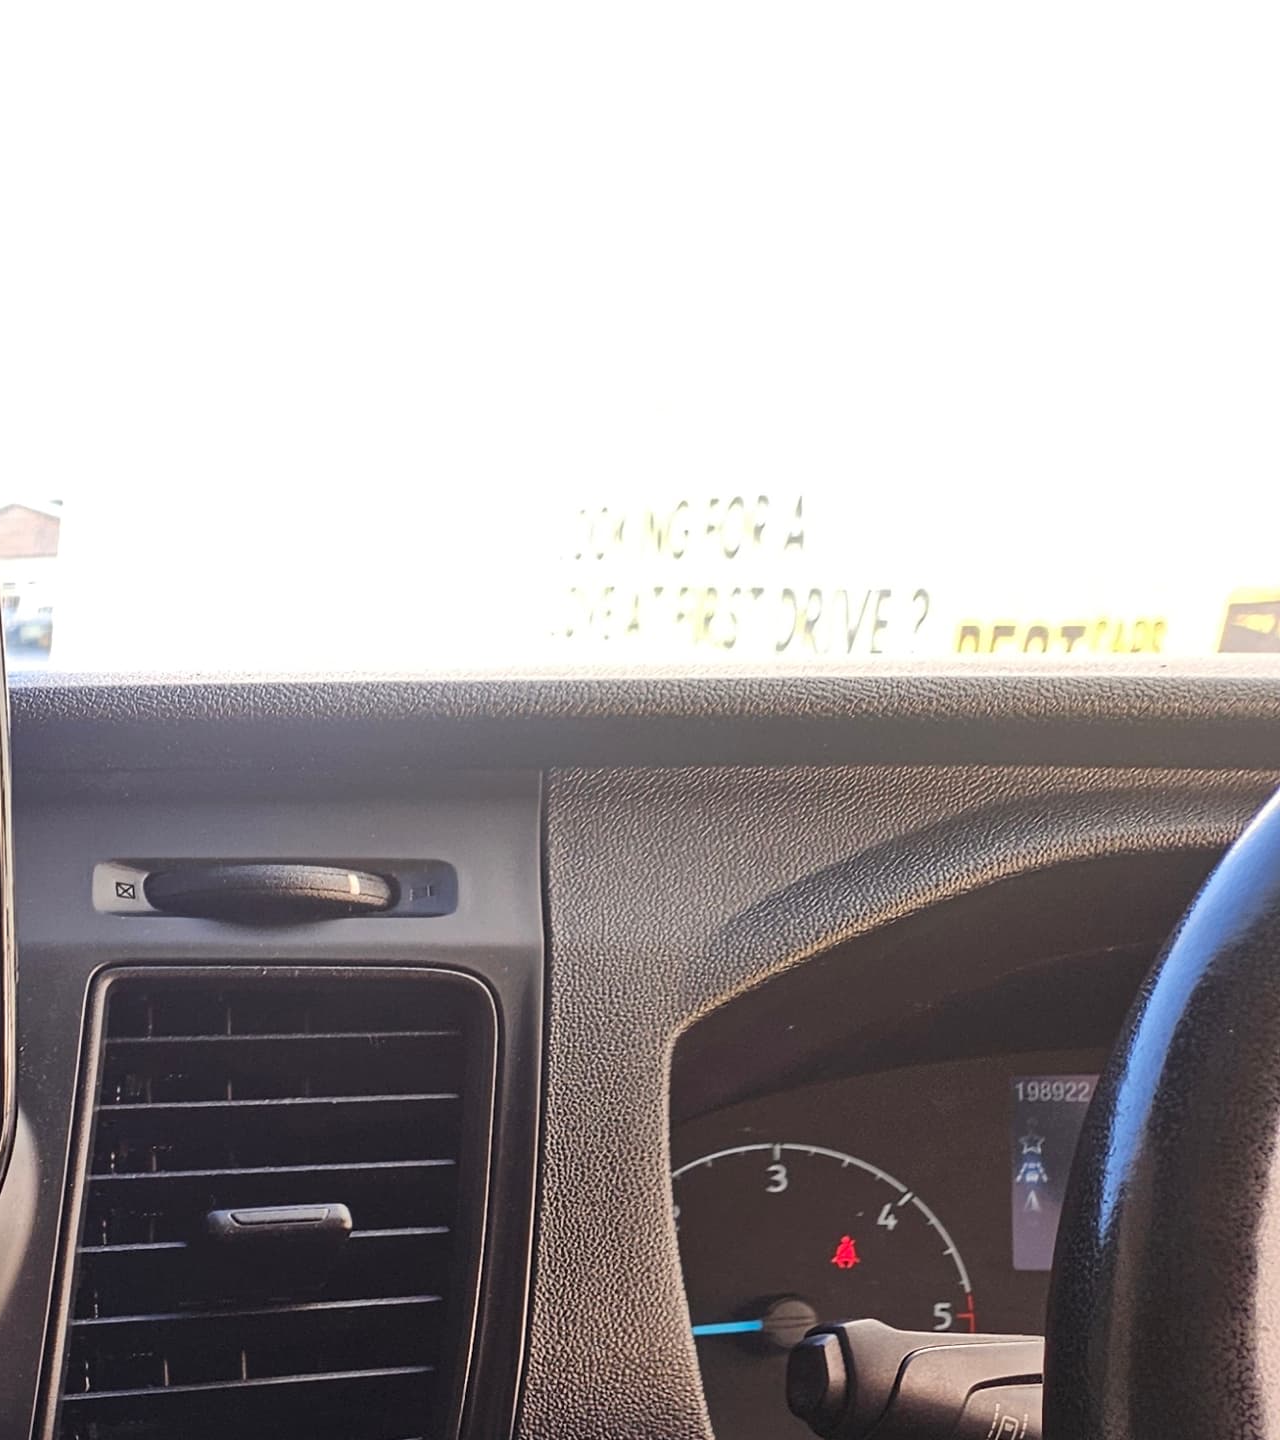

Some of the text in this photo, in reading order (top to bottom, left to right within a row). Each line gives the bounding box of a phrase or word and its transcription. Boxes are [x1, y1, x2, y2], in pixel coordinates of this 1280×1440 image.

[1014, 1081, 1091, 1101] 198922
[764, 1164, 789, 1193] 3
[876, 1203, 898, 1231] 4
[932, 1303, 952, 1331] 5
